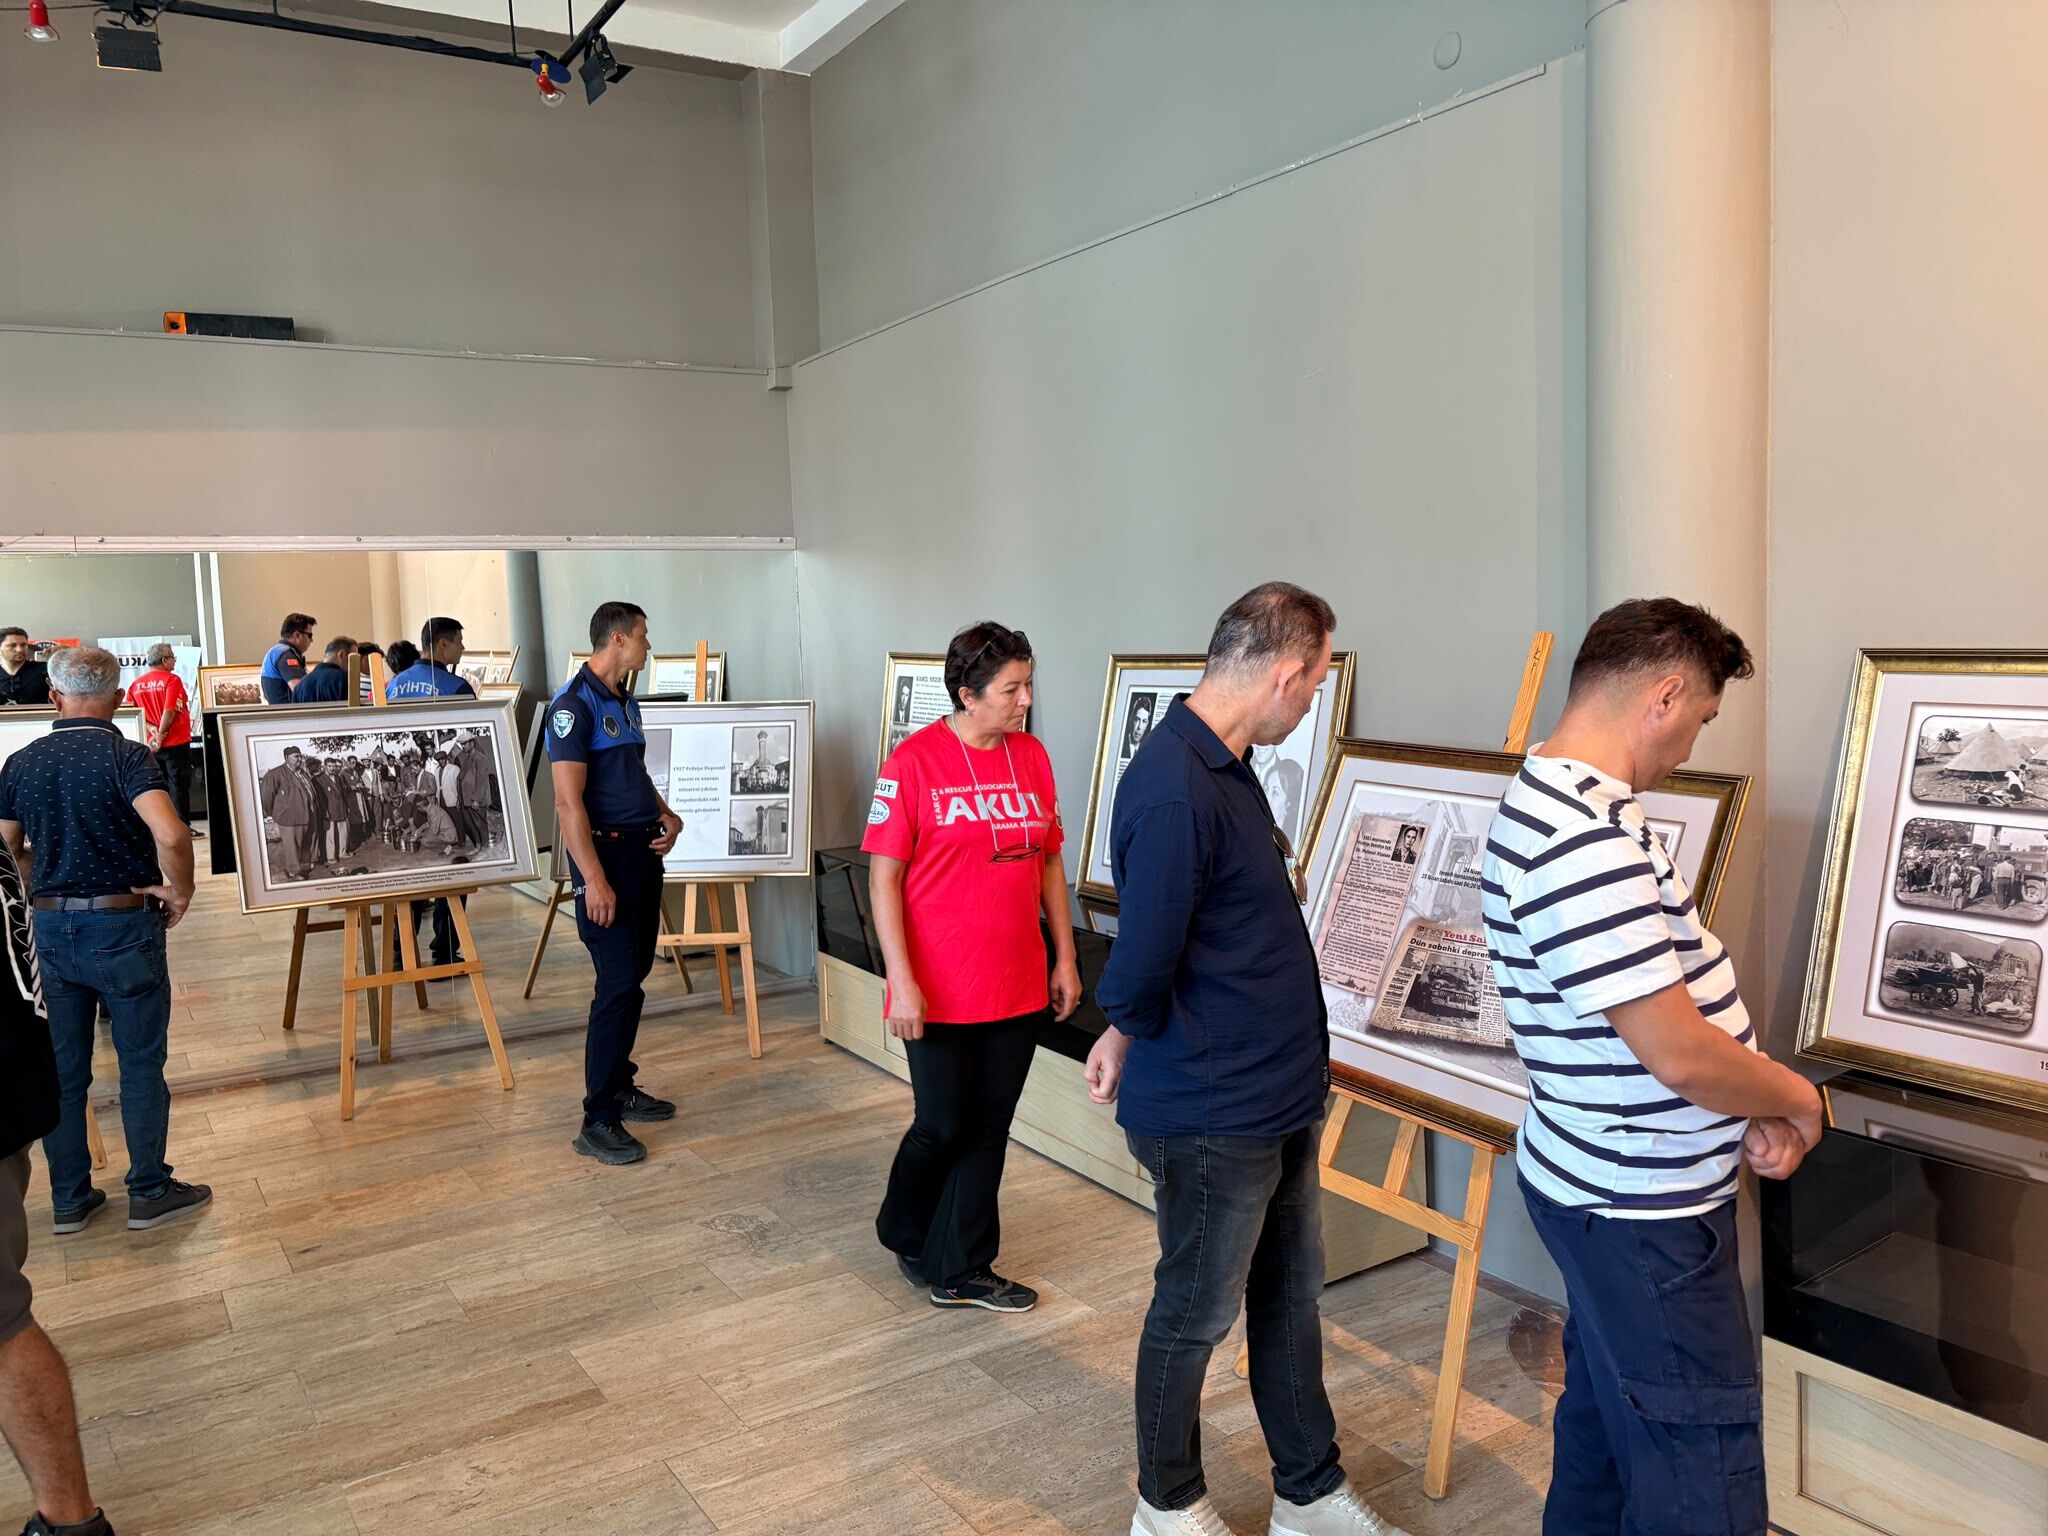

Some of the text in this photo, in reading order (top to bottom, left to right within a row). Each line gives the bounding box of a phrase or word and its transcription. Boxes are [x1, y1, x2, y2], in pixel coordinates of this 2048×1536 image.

[944, 786, 972, 794] RESCUE
[931, 789, 944, 826] SEARCH
[944, 793, 1042, 826] AKUT
[1443, 930, 1467, 941] Yeni
[1410, 937, 1426, 947] Dün
[1428, 943, 1460, 954] sabahki
